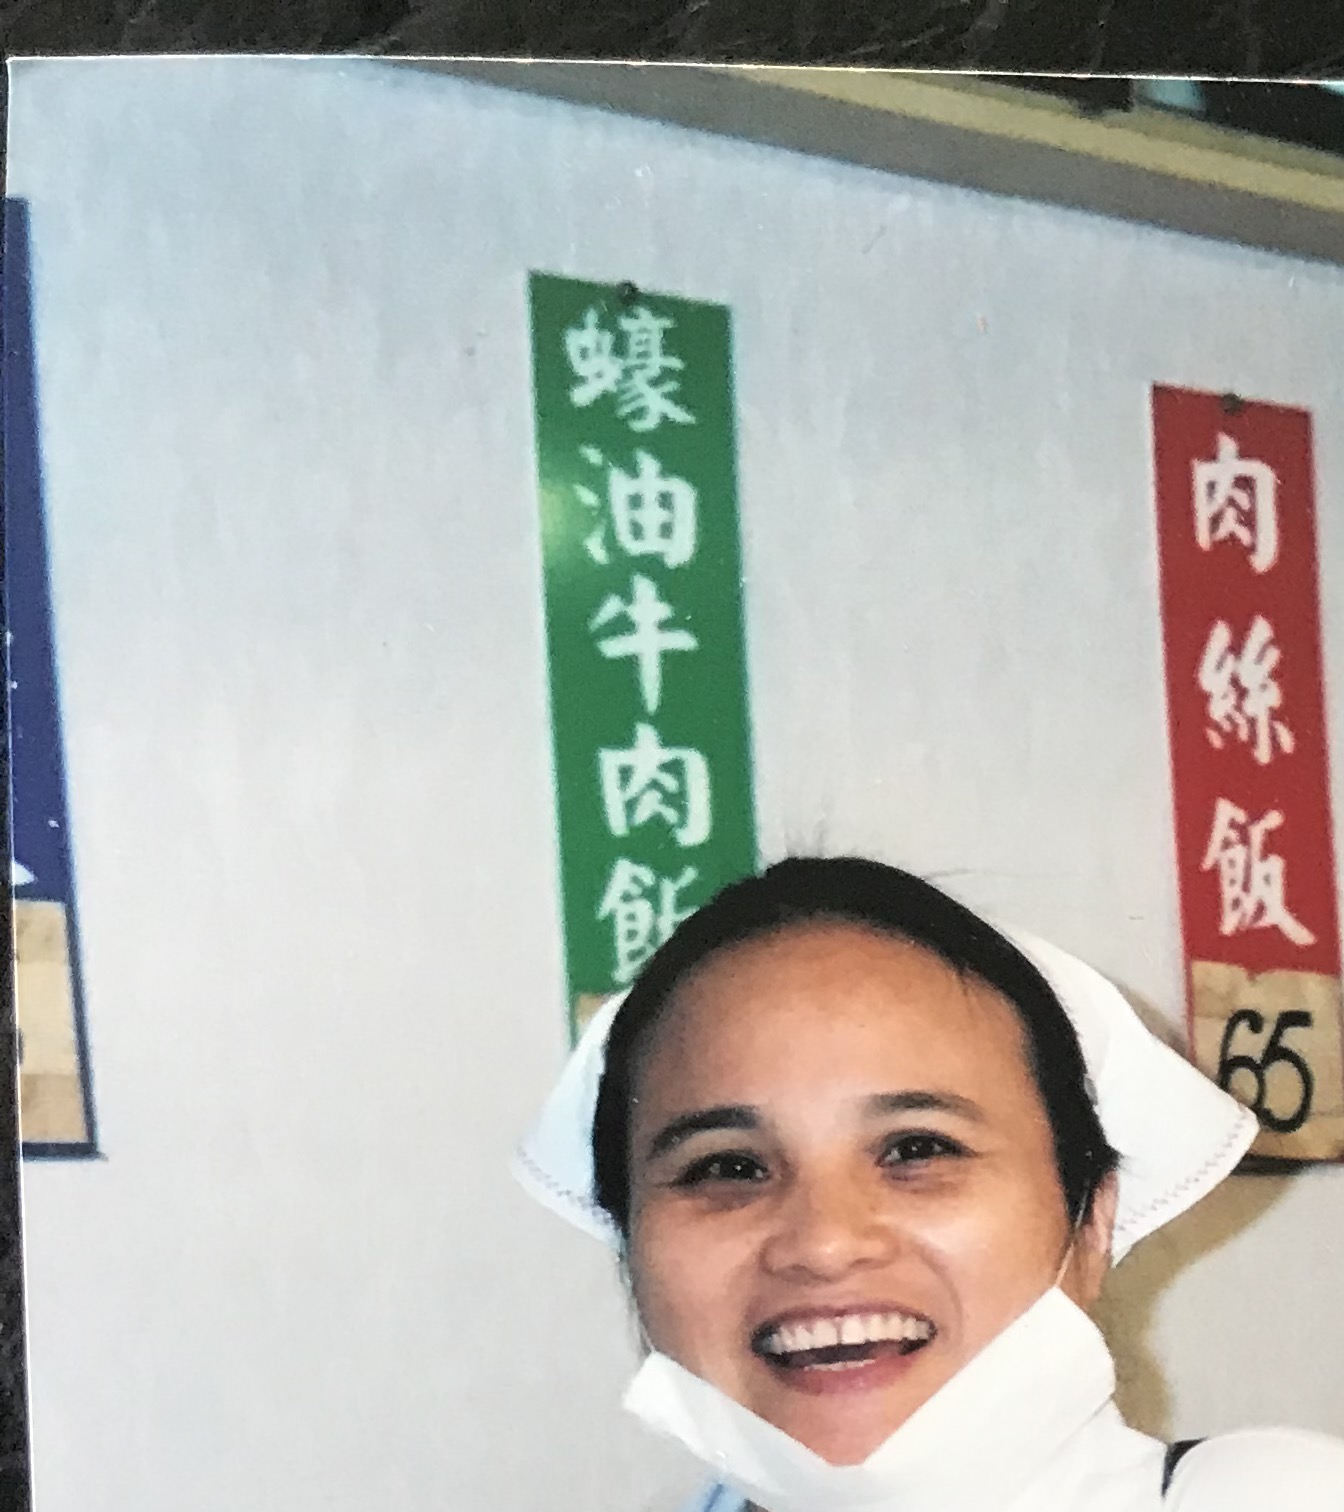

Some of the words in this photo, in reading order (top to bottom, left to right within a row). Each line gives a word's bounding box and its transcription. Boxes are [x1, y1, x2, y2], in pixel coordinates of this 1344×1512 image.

[563, 307, 714, 984] 蠔油牛肉飯
[1190, 436, 1316, 946] 肉絲飯
[1217, 1008, 1314, 1133] 65
